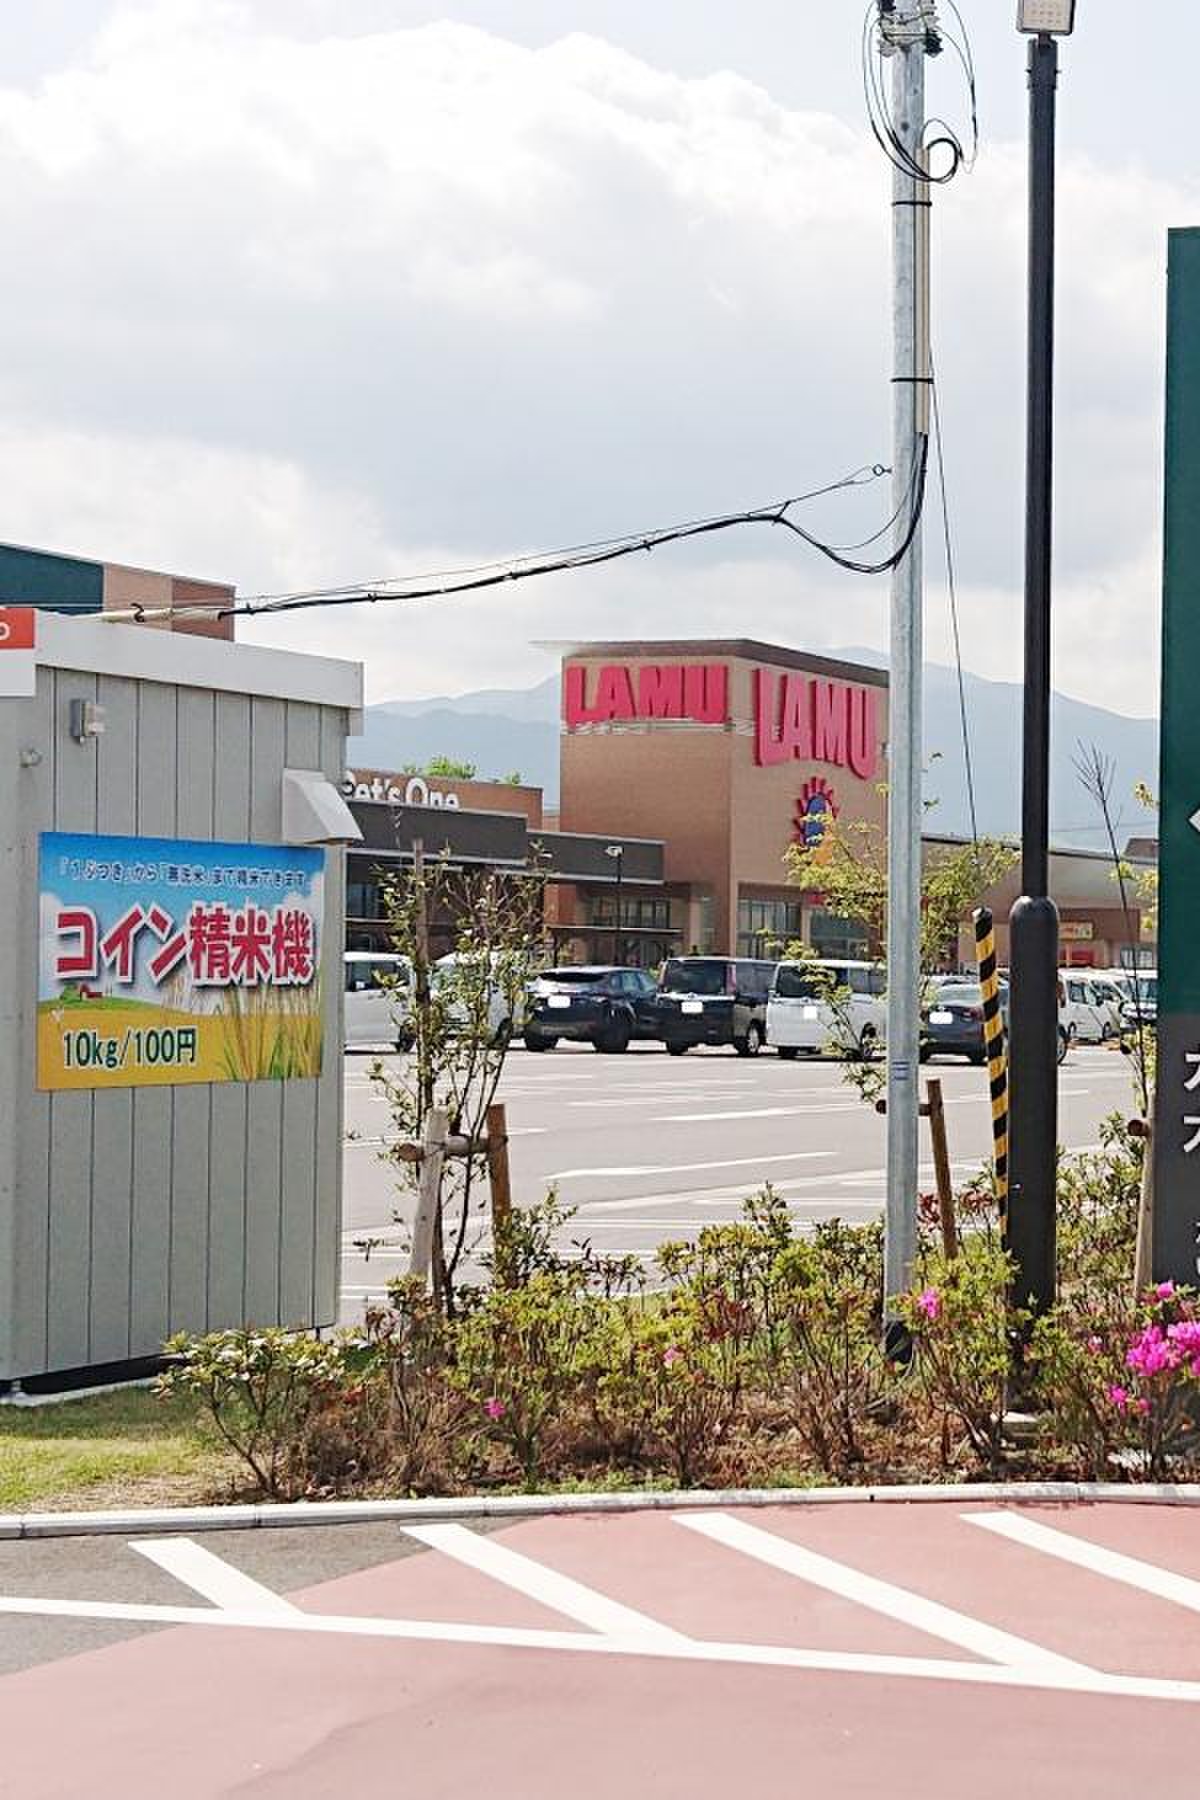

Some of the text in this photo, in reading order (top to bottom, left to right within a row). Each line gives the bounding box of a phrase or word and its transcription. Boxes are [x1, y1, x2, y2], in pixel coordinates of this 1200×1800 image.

[565, 664, 729, 727] LAMU
[752, 667, 877, 781] LAMU
[55, 903, 316, 981] コイン精米機
[63, 1026, 197, 1069] 10kg/100円
